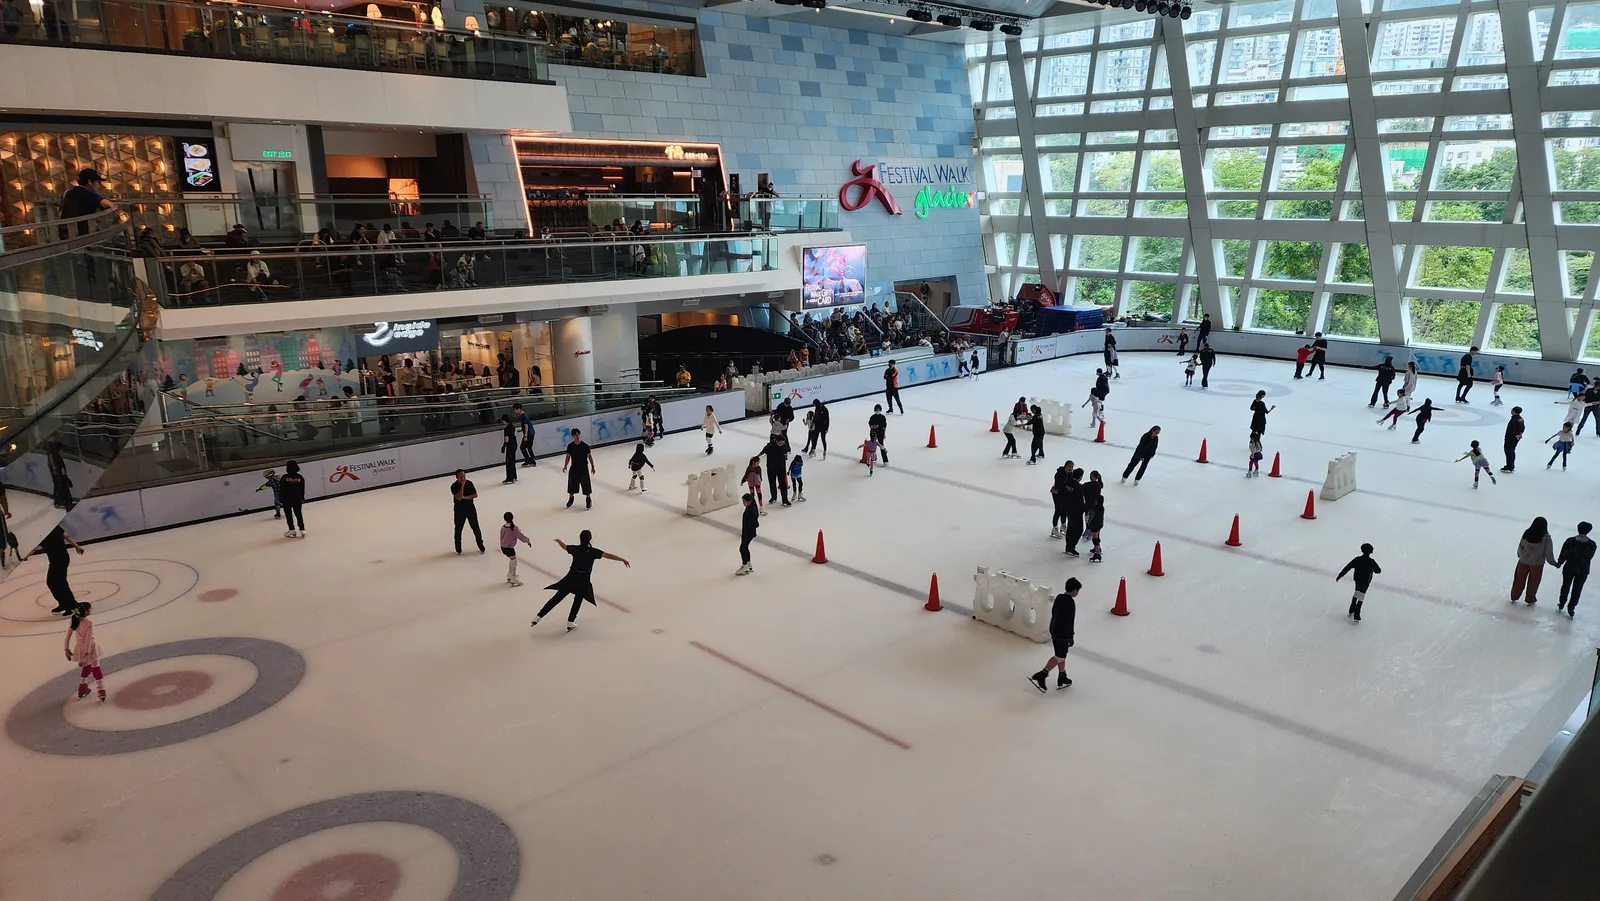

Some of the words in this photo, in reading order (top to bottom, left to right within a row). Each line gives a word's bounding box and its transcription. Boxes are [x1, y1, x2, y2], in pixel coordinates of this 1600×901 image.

[263, 150, 277, 158] EXIT
[878, 162, 934, 184] FESTIVAL
[934, 164, 970, 182] WALK
[915, 184, 977, 219] glacier
[818, 296, 832, 304] CARD
[393, 321, 431, 331] inside
[393, 329, 424, 339] edge
[349, 463, 377, 473] FESTIVAL
[376, 459, 396, 467] WALK
[372, 465, 396, 476] glacier
